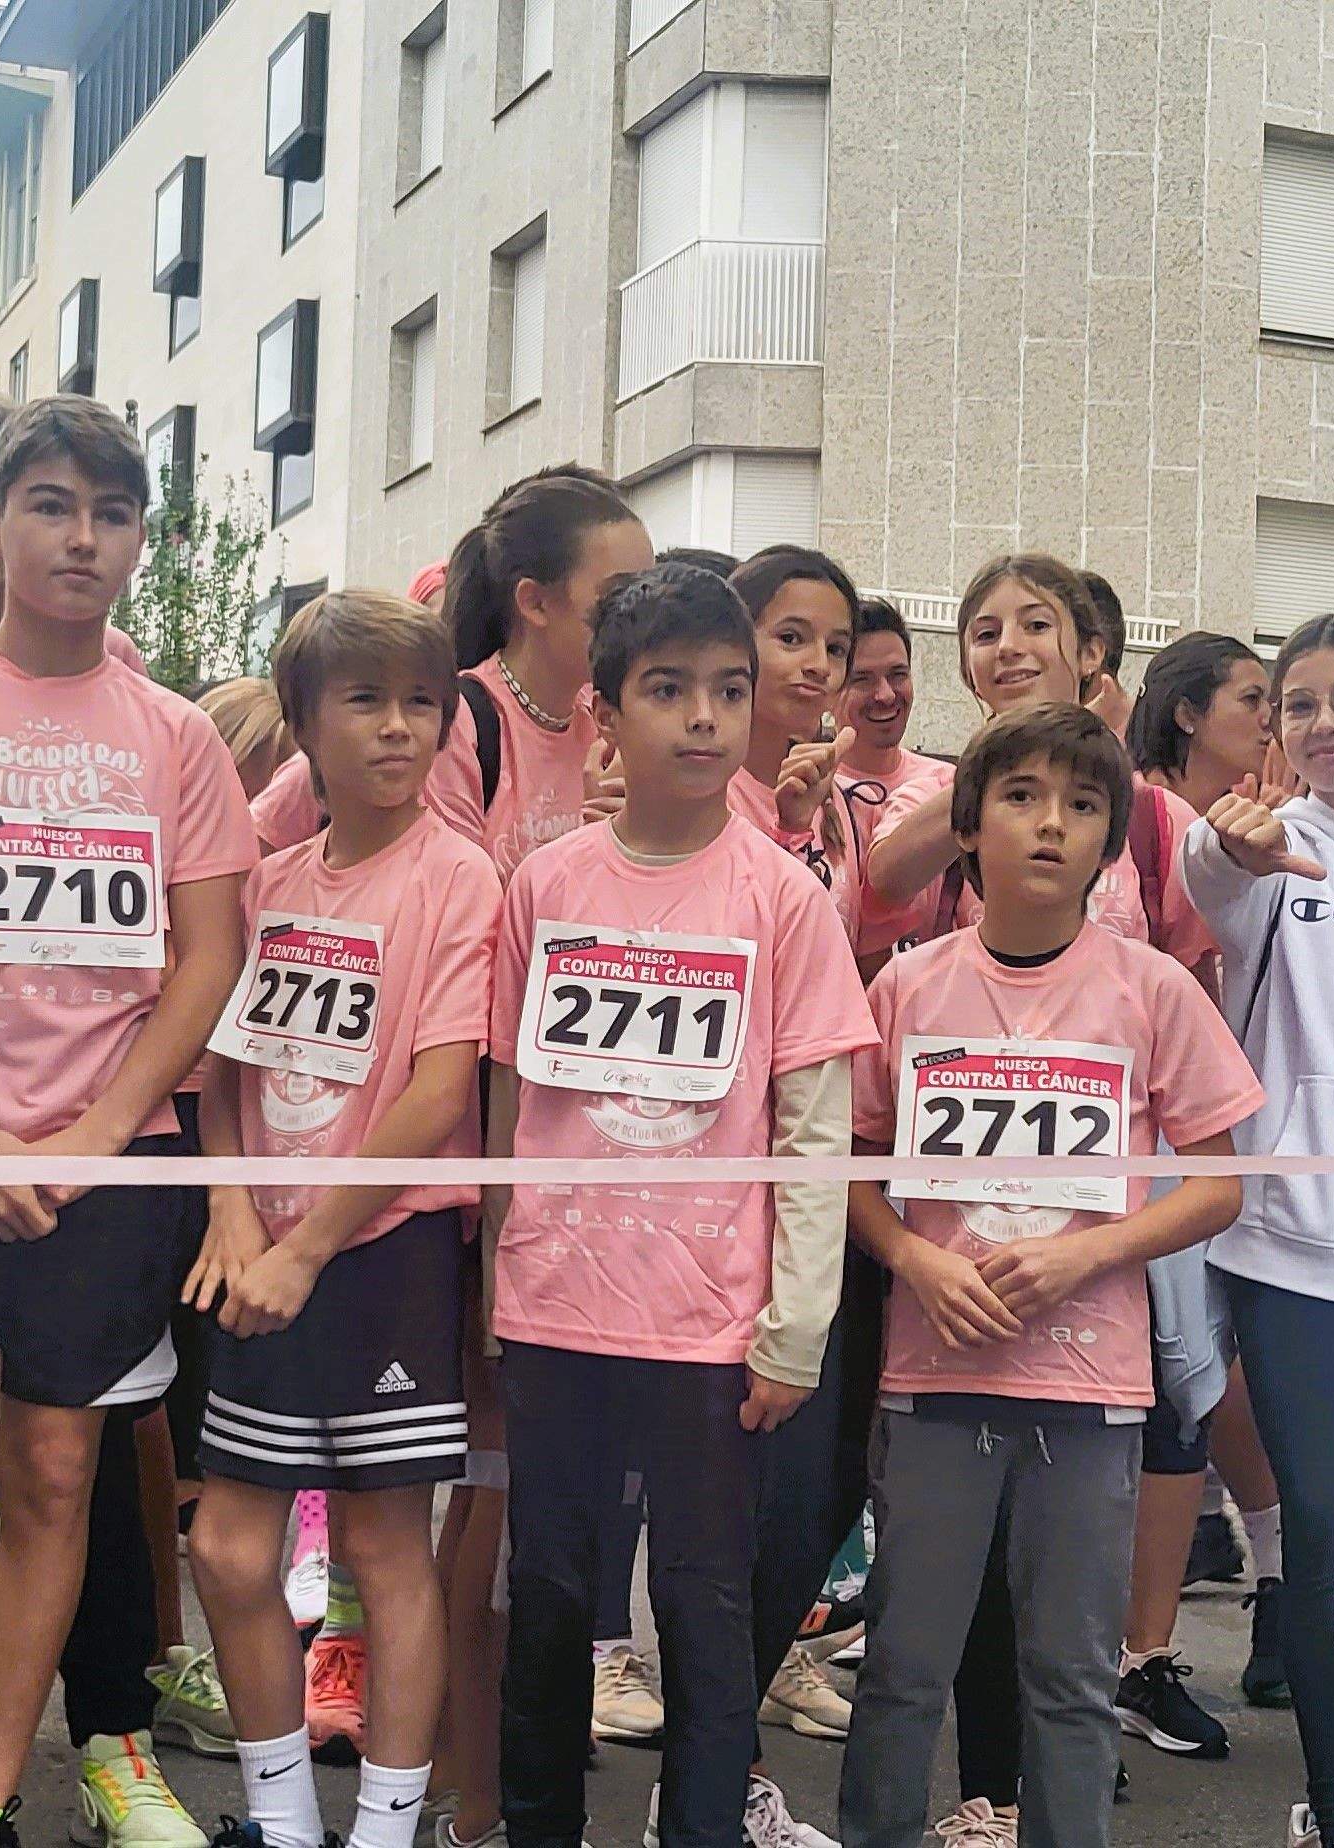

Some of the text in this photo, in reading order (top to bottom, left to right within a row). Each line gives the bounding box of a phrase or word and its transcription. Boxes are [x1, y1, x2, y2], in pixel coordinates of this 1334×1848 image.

[32, 827, 84, 842] HUESCA
[49, 842, 71, 857] EL
[74, 842, 145, 861] CÁNCER
[306, 934, 345, 950] HUESCA
[266, 943, 312, 962] CONTRA
[314, 949, 328, 965] EL
[624, 949, 676, 966] HUESCA
[558, 957, 735, 988] CONTRA EL CÁNCER
[245, 967, 376, 1040] 2713
[544, 984, 728, 1059] 2711
[994, 1058, 1050, 1071] HUESCA
[928, 1070, 1113, 1097] CONTRA EL CÁNCER
[919, 1096, 1112, 1156] 2712
[375, 1380, 416, 1393] adidas
